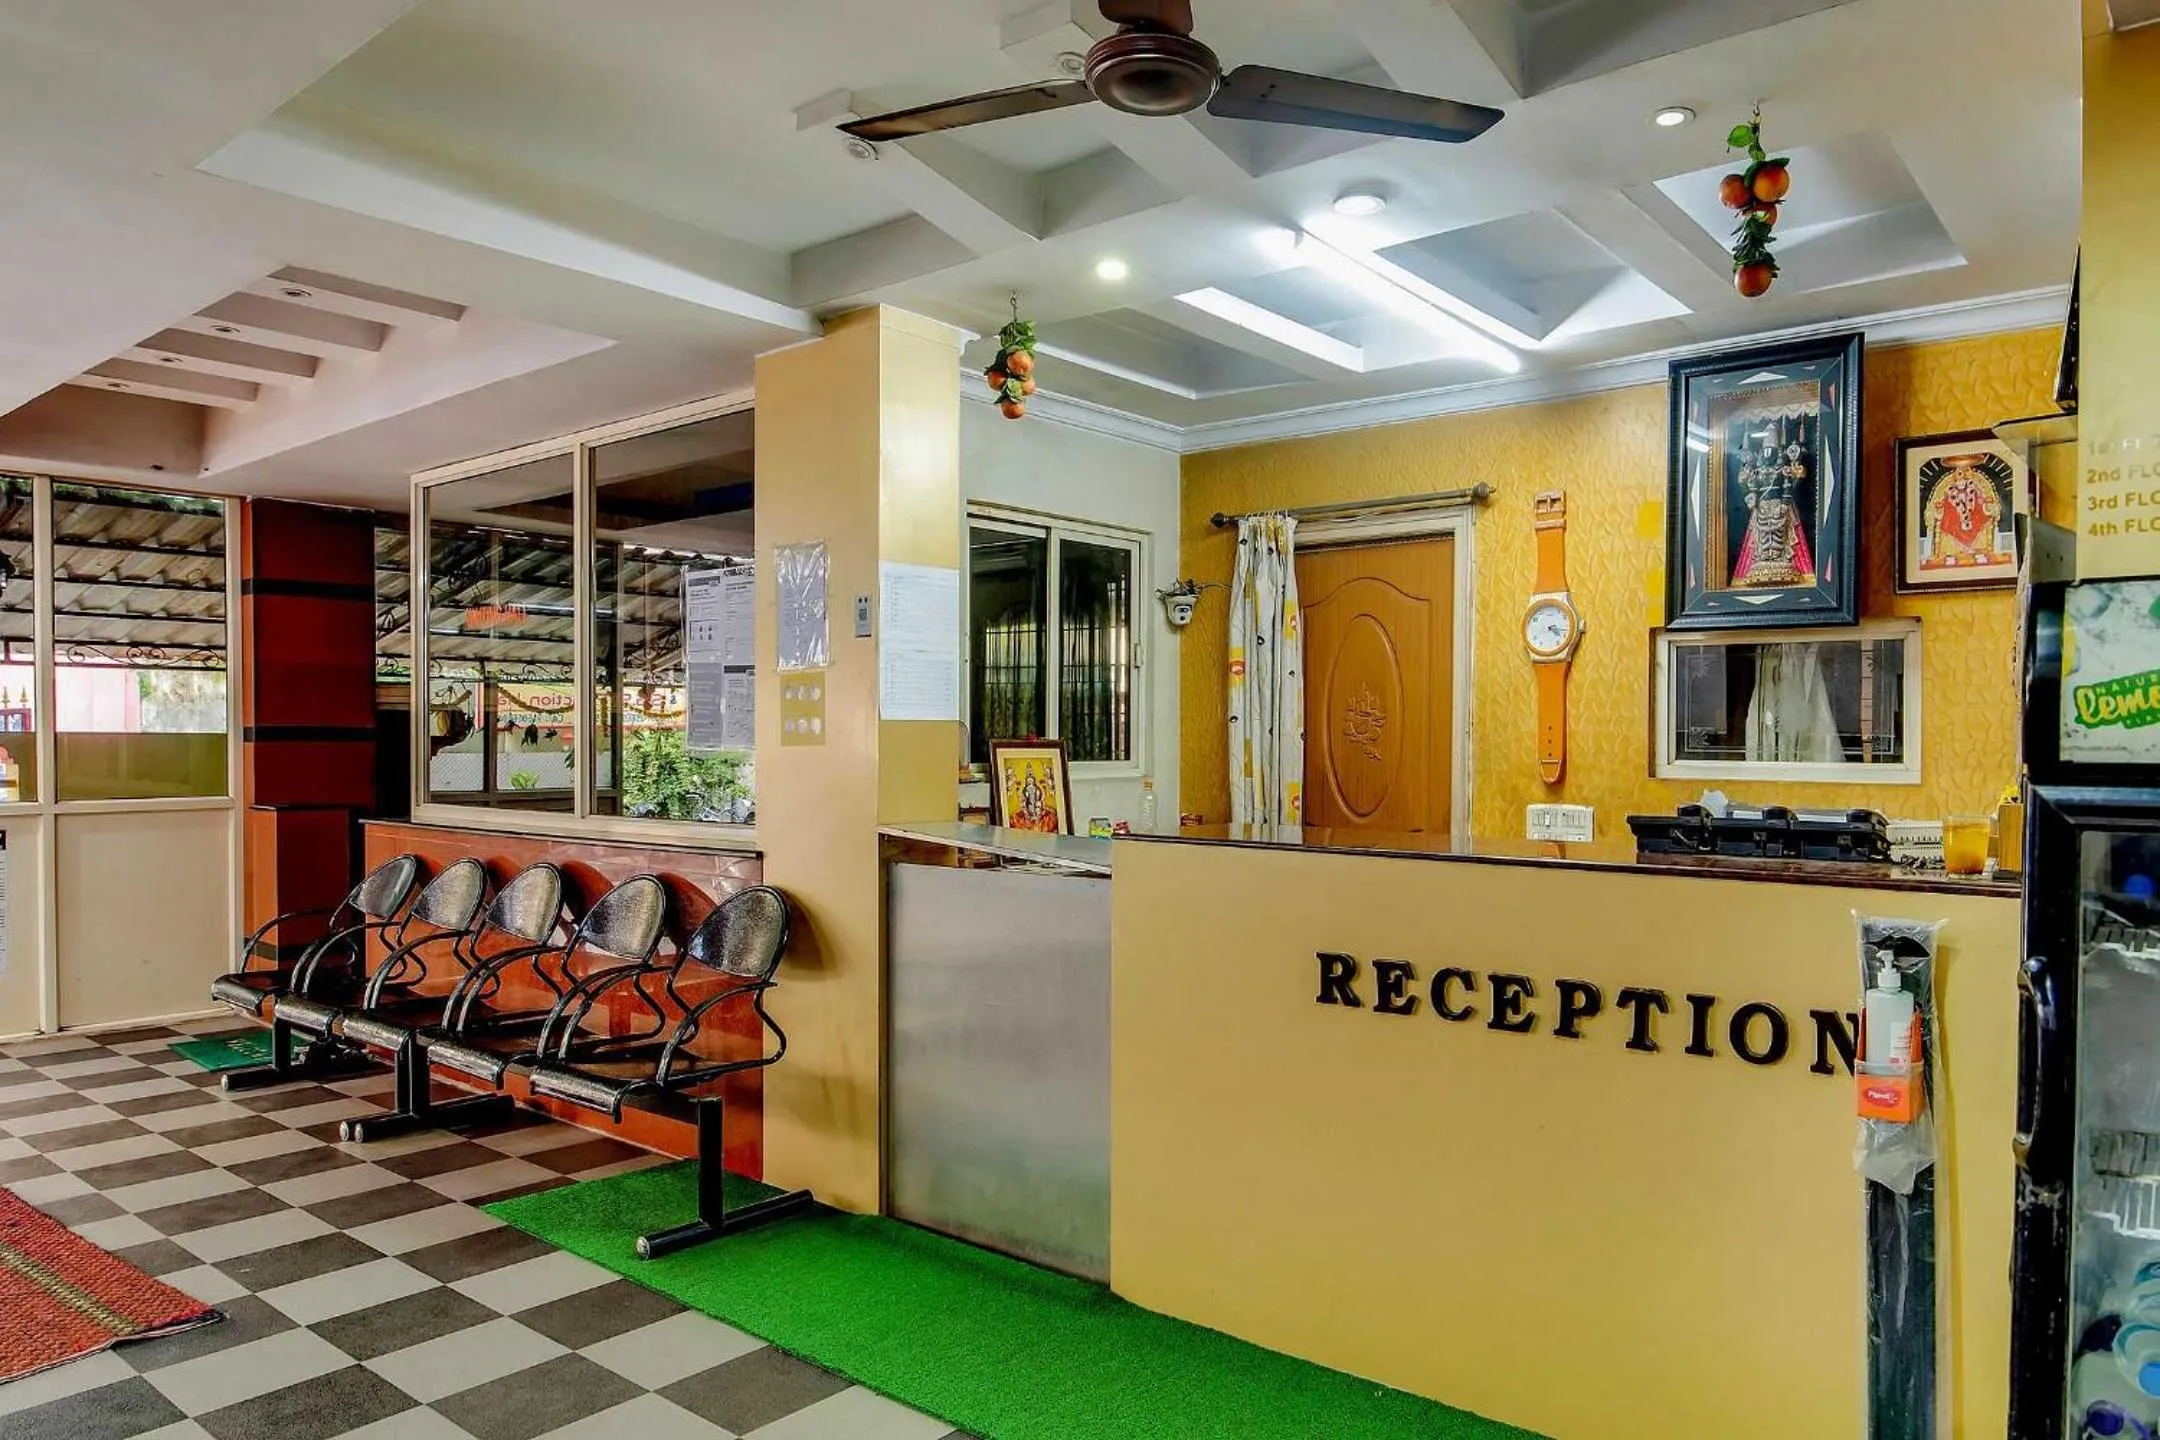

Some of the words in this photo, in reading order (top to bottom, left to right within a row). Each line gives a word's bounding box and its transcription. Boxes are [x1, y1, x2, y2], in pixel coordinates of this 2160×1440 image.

[2087, 467, 2121, 484] 2nd
[2088, 494, 2118, 511] 3rd
[2088, 521, 2118, 537] 4th
[1314, 951, 1860, 1077] RECEPTION
